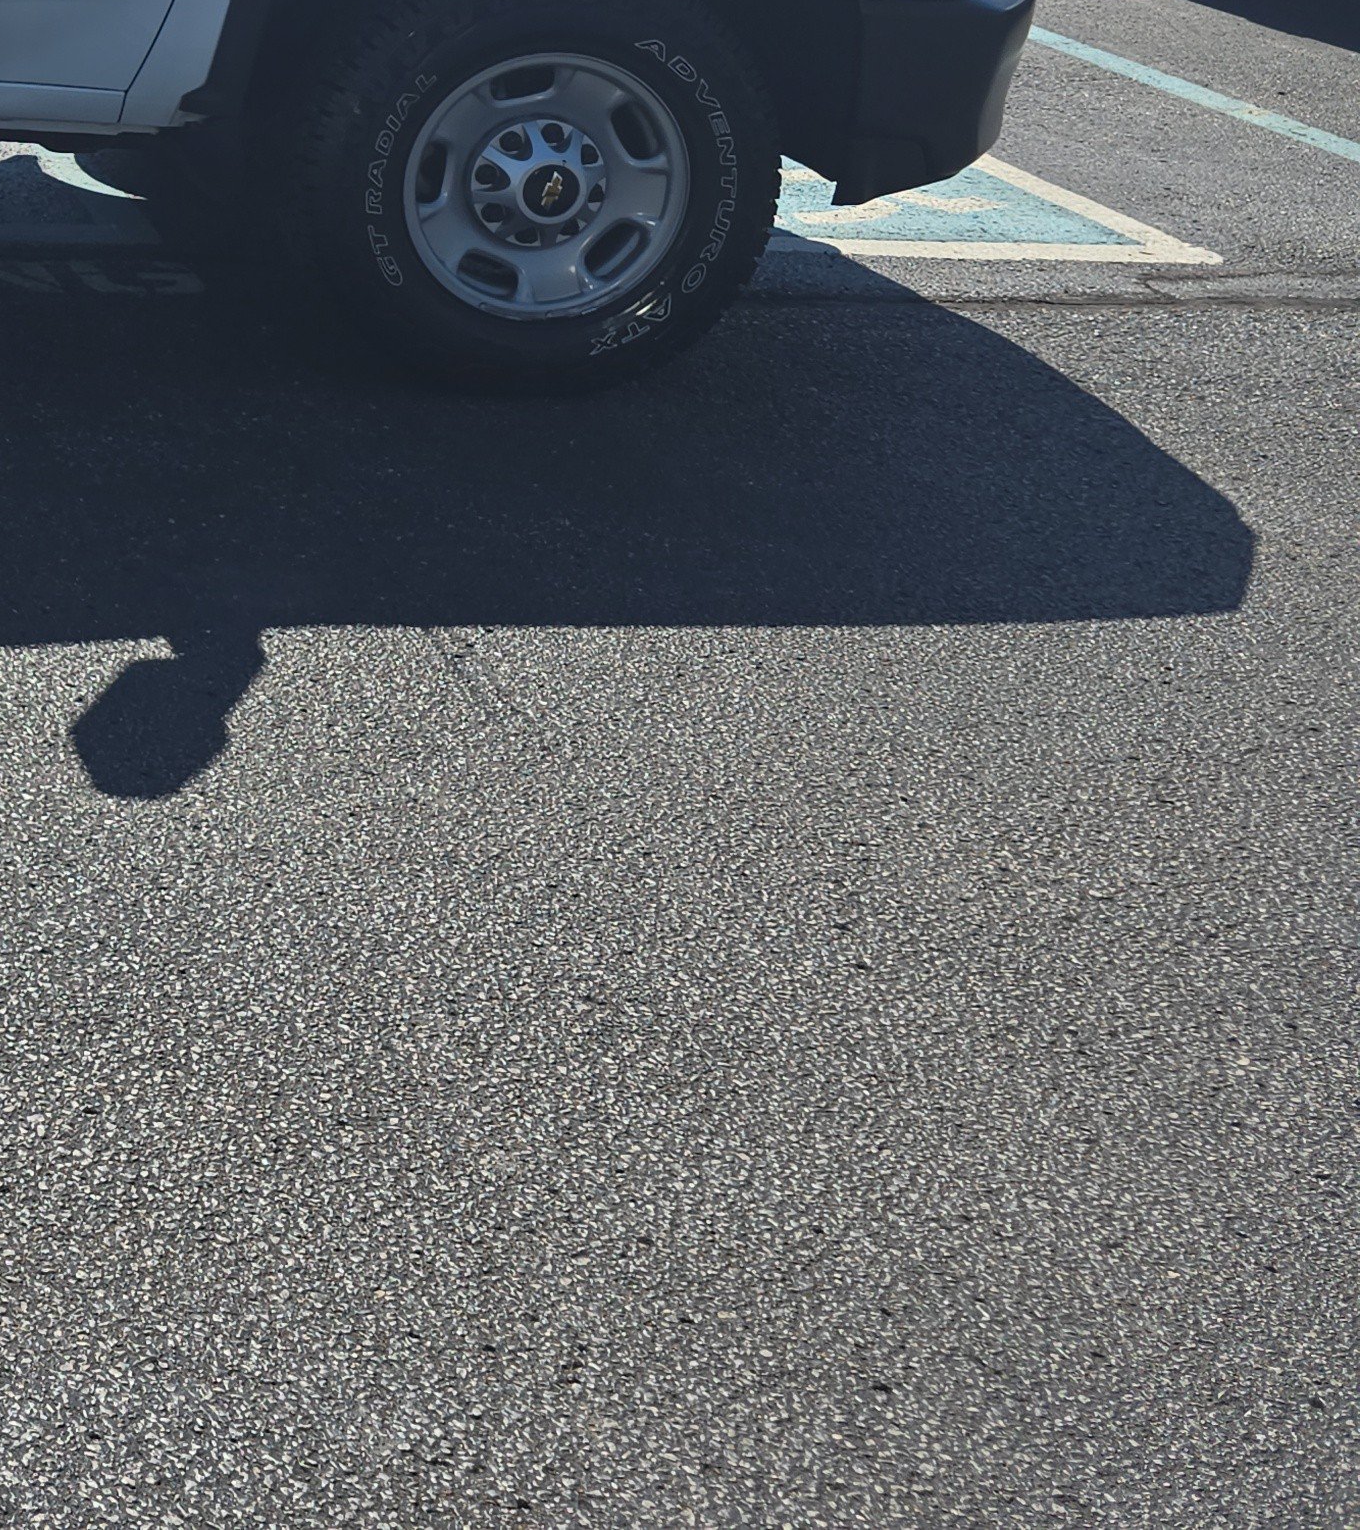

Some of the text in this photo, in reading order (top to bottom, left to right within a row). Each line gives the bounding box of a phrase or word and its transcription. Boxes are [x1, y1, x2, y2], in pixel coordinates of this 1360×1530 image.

[365, 73, 438, 287] GT RADIAL
[589, 39, 738, 356] ADVENTURO ATX
